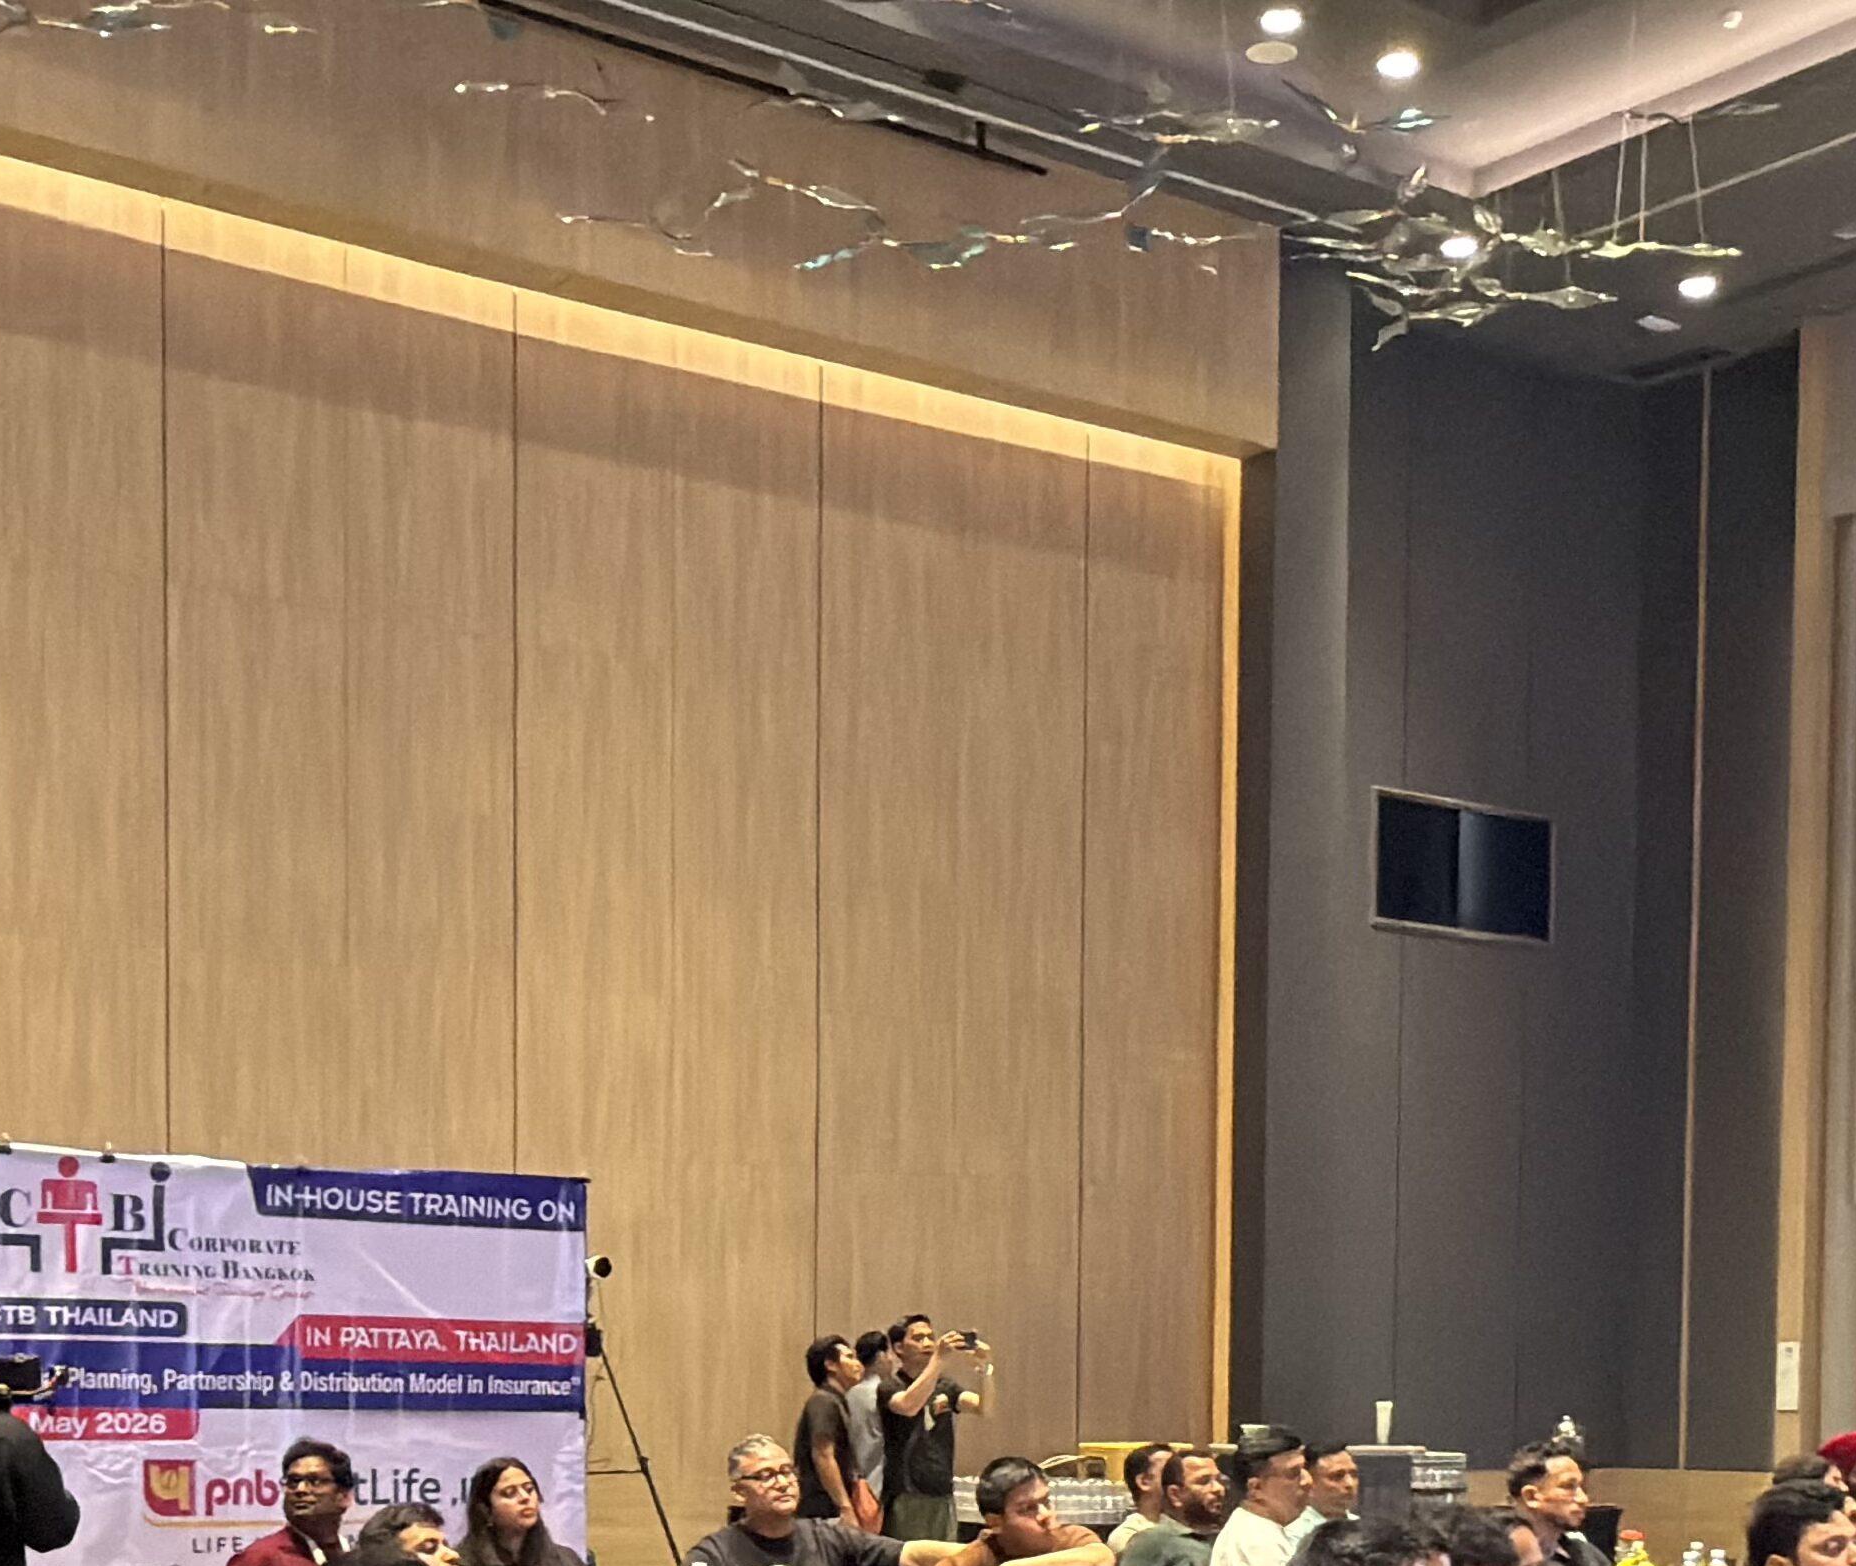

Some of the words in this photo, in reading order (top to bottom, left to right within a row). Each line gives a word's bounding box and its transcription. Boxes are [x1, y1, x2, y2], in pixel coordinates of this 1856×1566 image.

[265, 1183, 402, 1214] IN-HOUSE
[406, 1191, 533, 1221] TRAINING
[537, 1199, 576, 1223] ON
[167, 1227, 302, 1256] CORPORATE
[117, 1254, 217, 1279] TRAINING
[222, 1259, 316, 1282] BANGKOK
[44, 1303, 179, 1329] THAILAND
[305, 1325, 332, 1349] IN
[455, 1329, 579, 1355] THAILAND
[67, 1367, 159, 1395] Planning,
[163, 1370, 275, 1396] Partnership
[279, 1370, 295, 1392] &
[300, 1370, 405, 1395] Distribution
[409, 1372, 464, 1395] Model
[466, 1374, 484, 1395] in
[29, 1411, 87, 1438] May
[95, 1412, 167, 1434] 2026
[204, 1468, 280, 1516] pnb
[352, 1467, 442, 1506] tLife
[191, 1535, 244, 1554] LIFE
